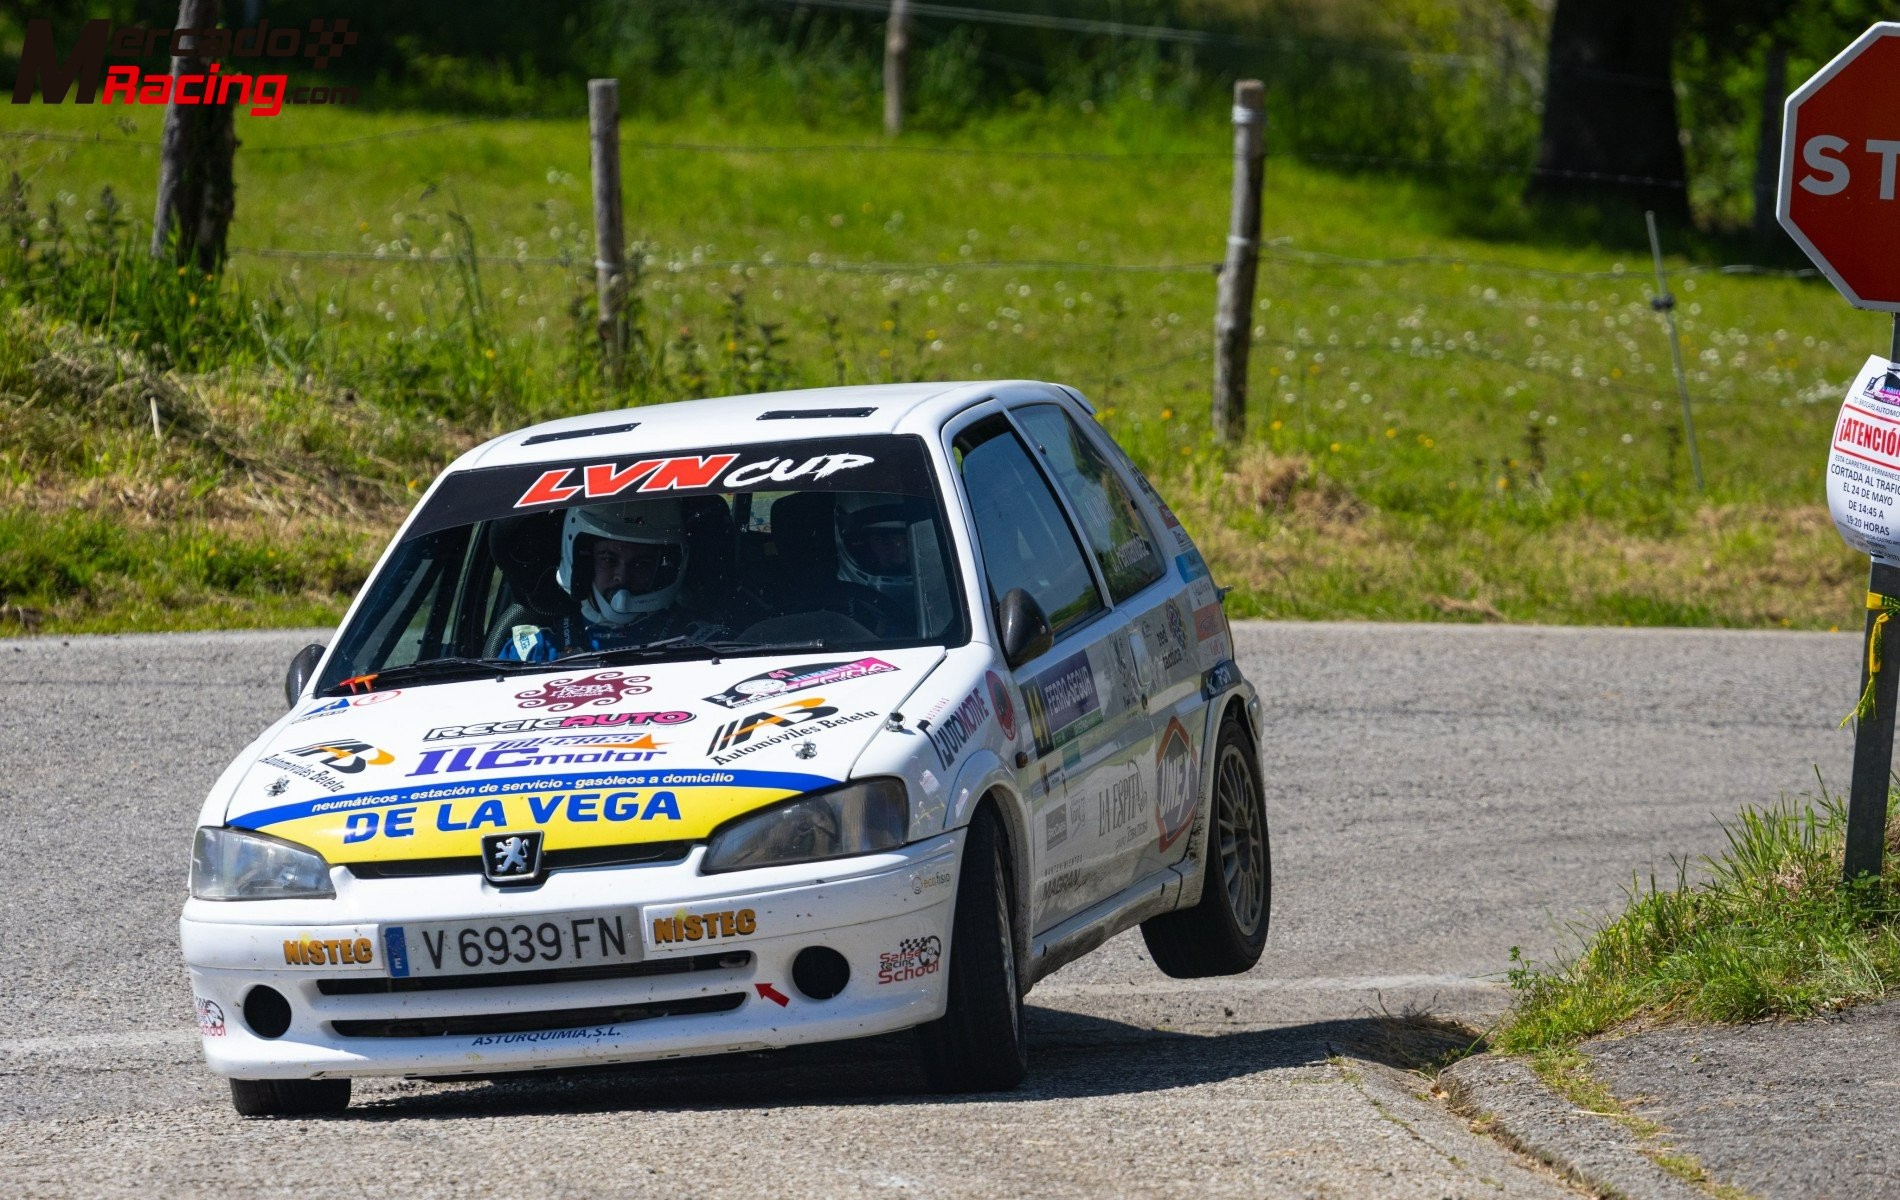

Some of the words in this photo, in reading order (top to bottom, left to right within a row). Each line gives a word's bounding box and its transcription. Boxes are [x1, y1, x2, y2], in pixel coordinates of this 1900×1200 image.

[512, 453, 741, 508] LVN
[723, 453, 875, 489] CUP
[1831, 463, 1863, 484] CORTADA
[1865, 476, 1874, 487] AL
[1843, 482, 1850, 492] EL
[1851, 485, 1860, 495] 24
[1861, 488, 1870, 499] DE
[1872, 491, 1893, 506] MAYO
[1848, 499, 1857, 511] DE
[1859, 503, 1877, 517] 14:45
[1879, 510, 1885, 520] A
[1863, 520, 1890, 536] HORAS
[423, 711, 697, 742] RECICAUTO
[526, 749, 668, 768] motor
[711, 724, 822, 766] Automóviles
[311, 793, 399, 813] neumáticos
[410, 785, 476, 800] estación
[478, 783, 499, 793] de
[501, 778, 563, 792] servicio
[574, 775, 645, 789] gasóleos
[662, 773, 735, 784] domicilio
[343, 806, 418, 844] DE
[436, 799, 508, 832] LA
[527, 790, 682, 825] VEGA
[653, 908, 757, 945] NISTEC
[283, 937, 373, 966] NISTEC
[421, 930, 445, 970] V
[457, 922, 562, 967] 6939
[571, 915, 626, 959] FN
[878, 960, 939, 985] School
[879, 958, 915, 970] Racing
